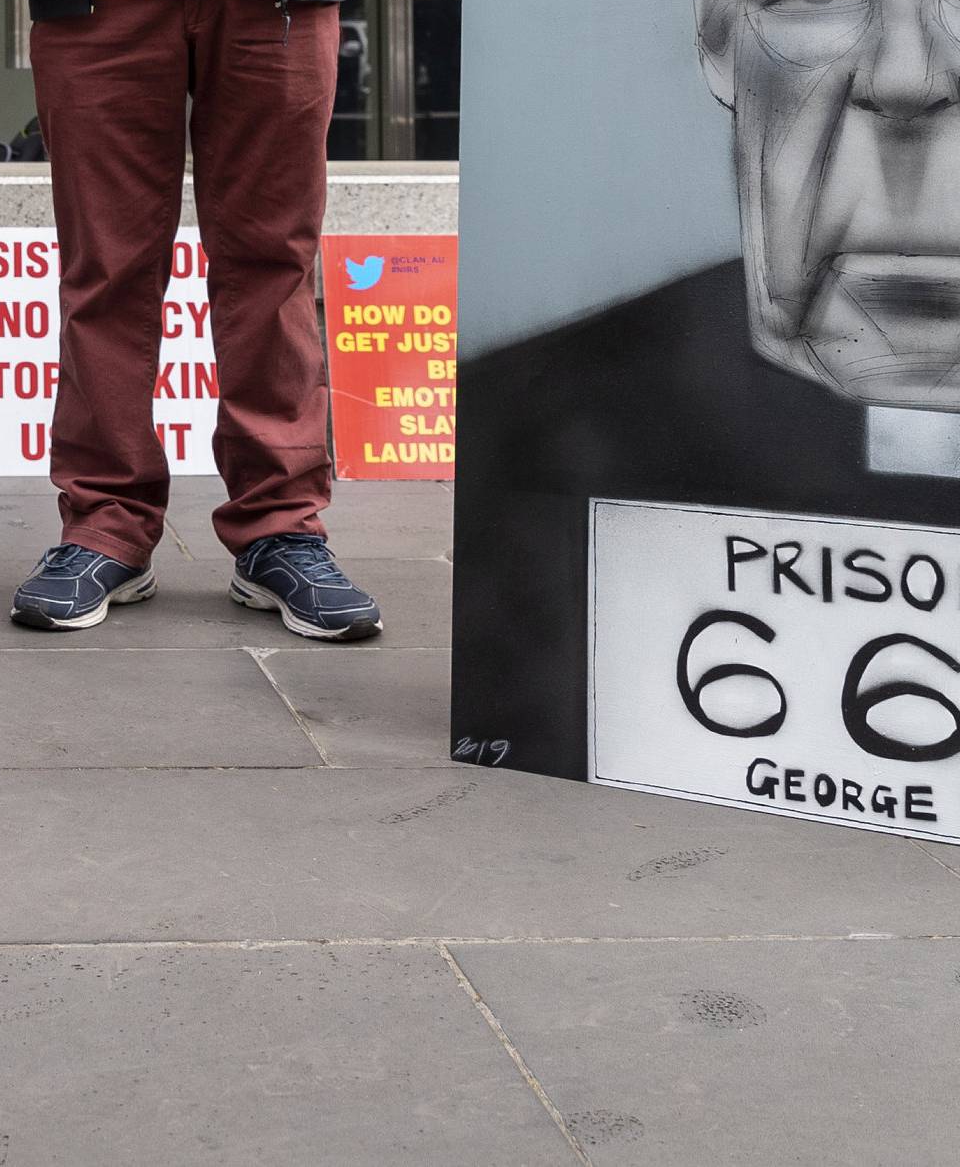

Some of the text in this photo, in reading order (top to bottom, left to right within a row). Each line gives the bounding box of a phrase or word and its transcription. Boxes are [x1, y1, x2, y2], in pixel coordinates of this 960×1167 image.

[343, 305, 452, 325] HOW DO
[336, 332, 389, 352] GET
[725, 534, 960, 612] PRISO
[745, 757, 937, 822] GEORGE
